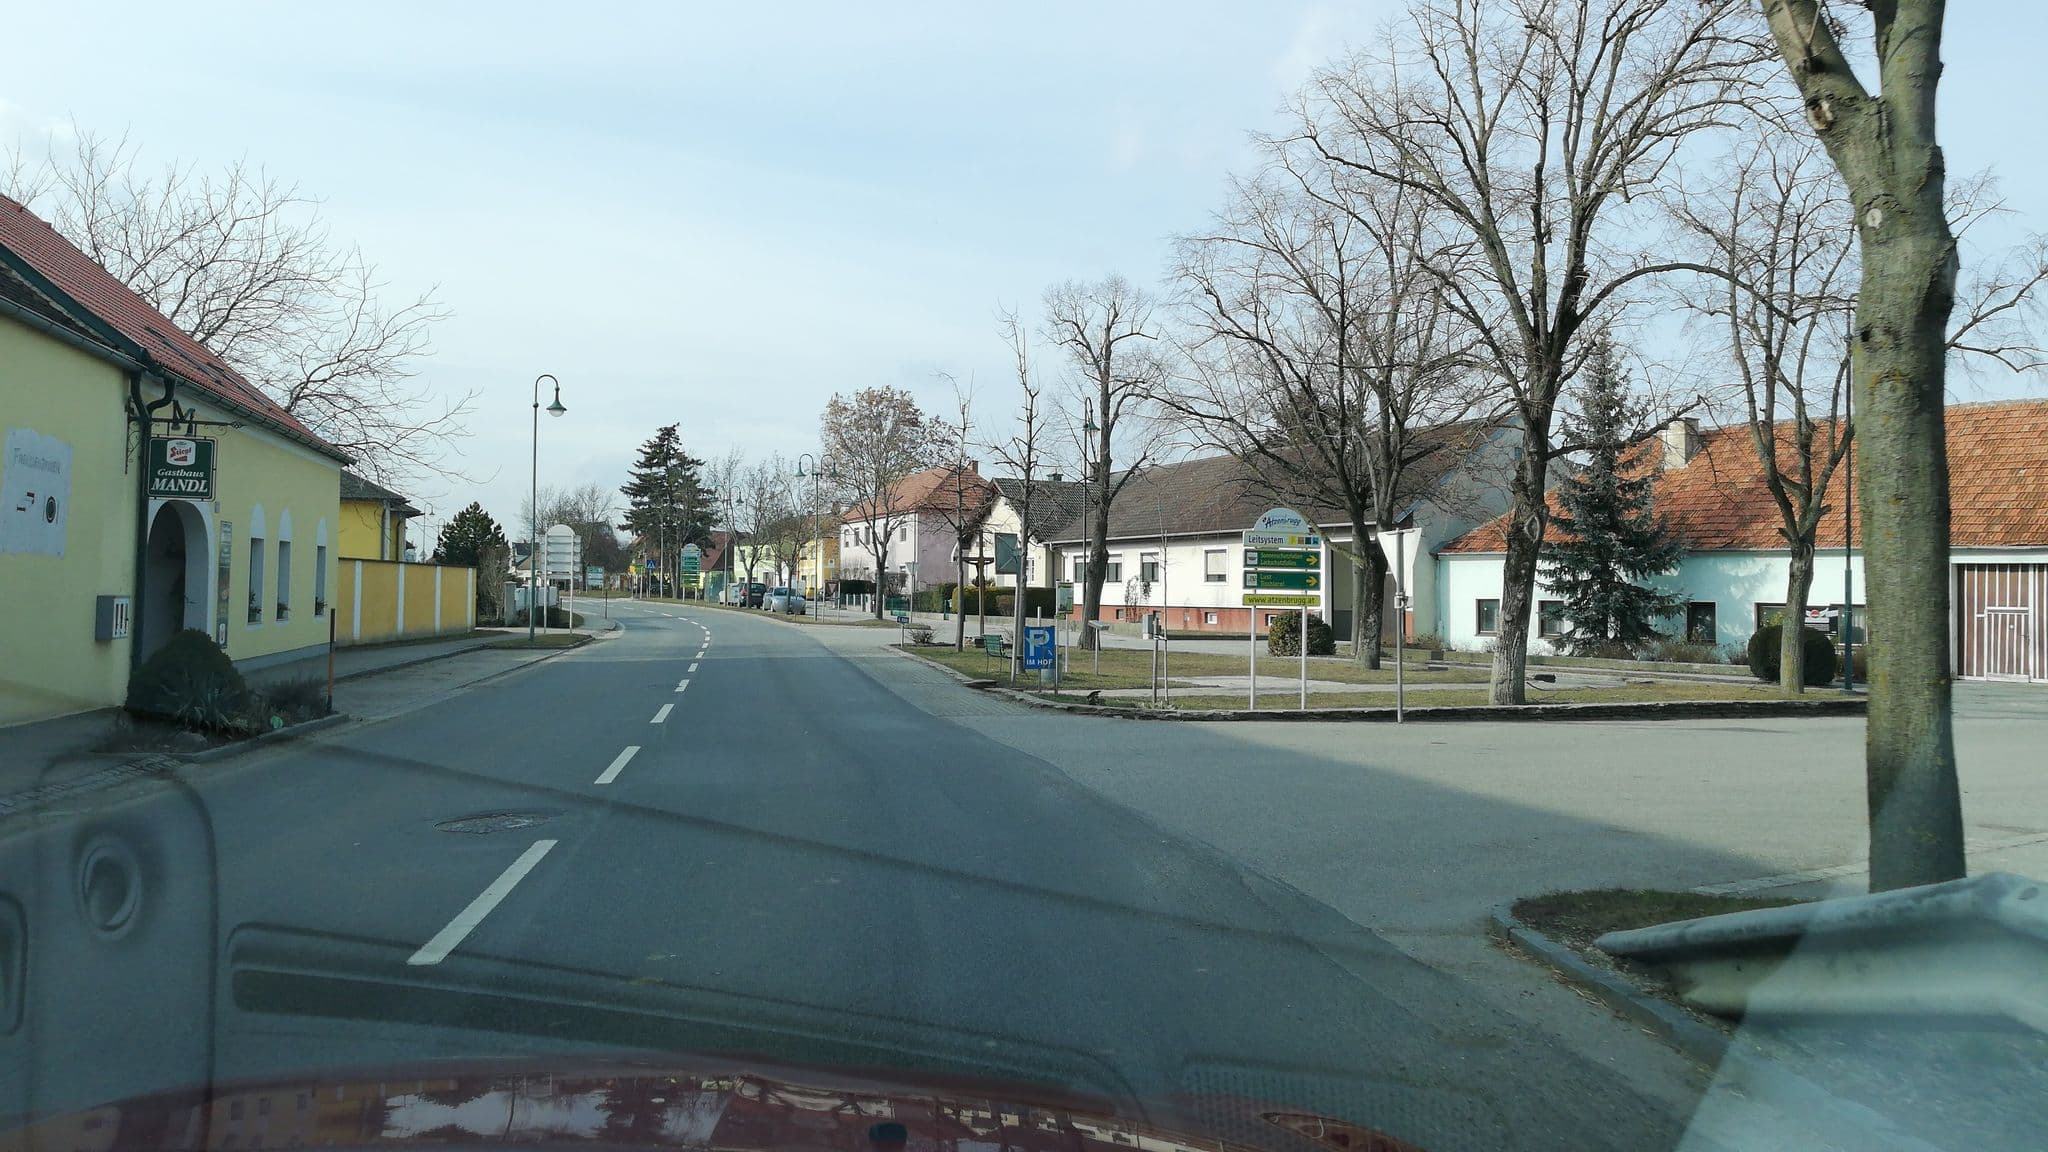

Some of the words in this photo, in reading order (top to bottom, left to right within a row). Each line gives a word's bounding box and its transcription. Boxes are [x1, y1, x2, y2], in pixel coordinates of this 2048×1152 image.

[157, 468, 204, 478] Gasthaus
[150, 478, 208, 492] MANDL
[1248, 535, 1284, 545] Leitsystem
[1248, 596, 1315, 605] www.atzenbrugg.at
